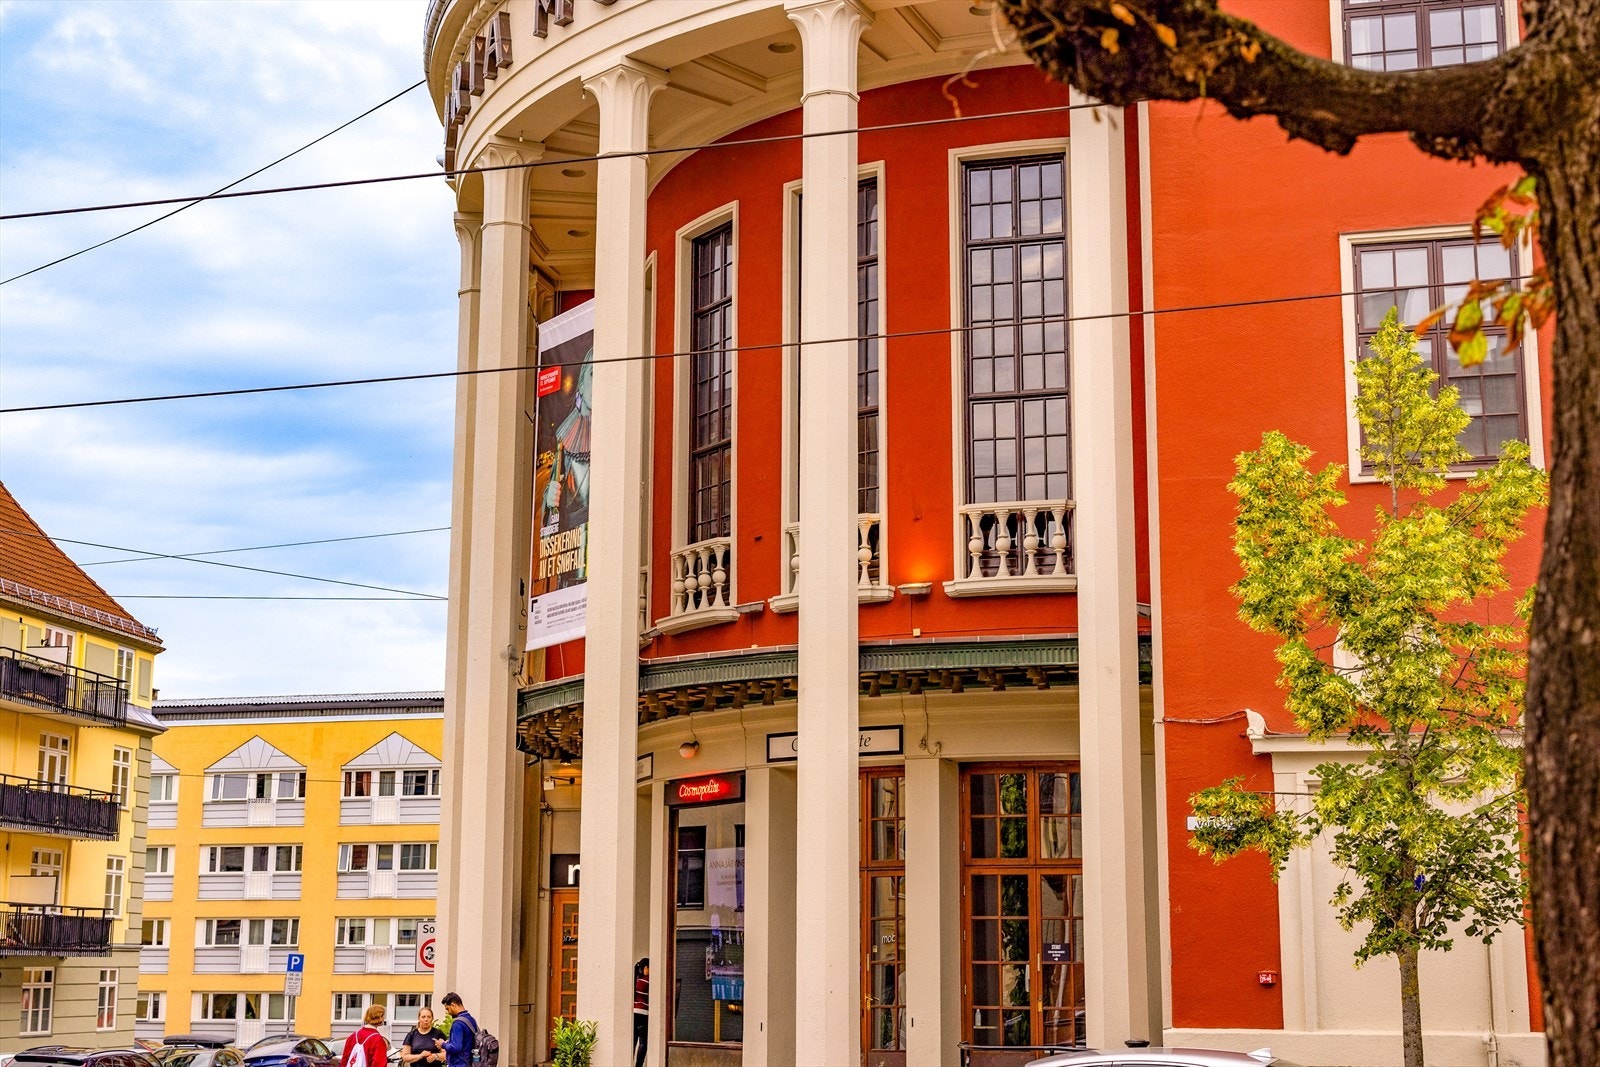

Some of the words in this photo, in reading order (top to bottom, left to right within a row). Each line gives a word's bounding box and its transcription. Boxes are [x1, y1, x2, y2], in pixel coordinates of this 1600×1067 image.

[540, 527, 582, 558] DISSEKERING
[539, 559, 547, 580] AV
[548, 557, 556, 577] ET
[557, 549, 586, 574] SNØFALL
[679, 779, 720, 801] Cosmopolite
[423, 924, 435, 933] So
[291, 956, 300, 969] P
